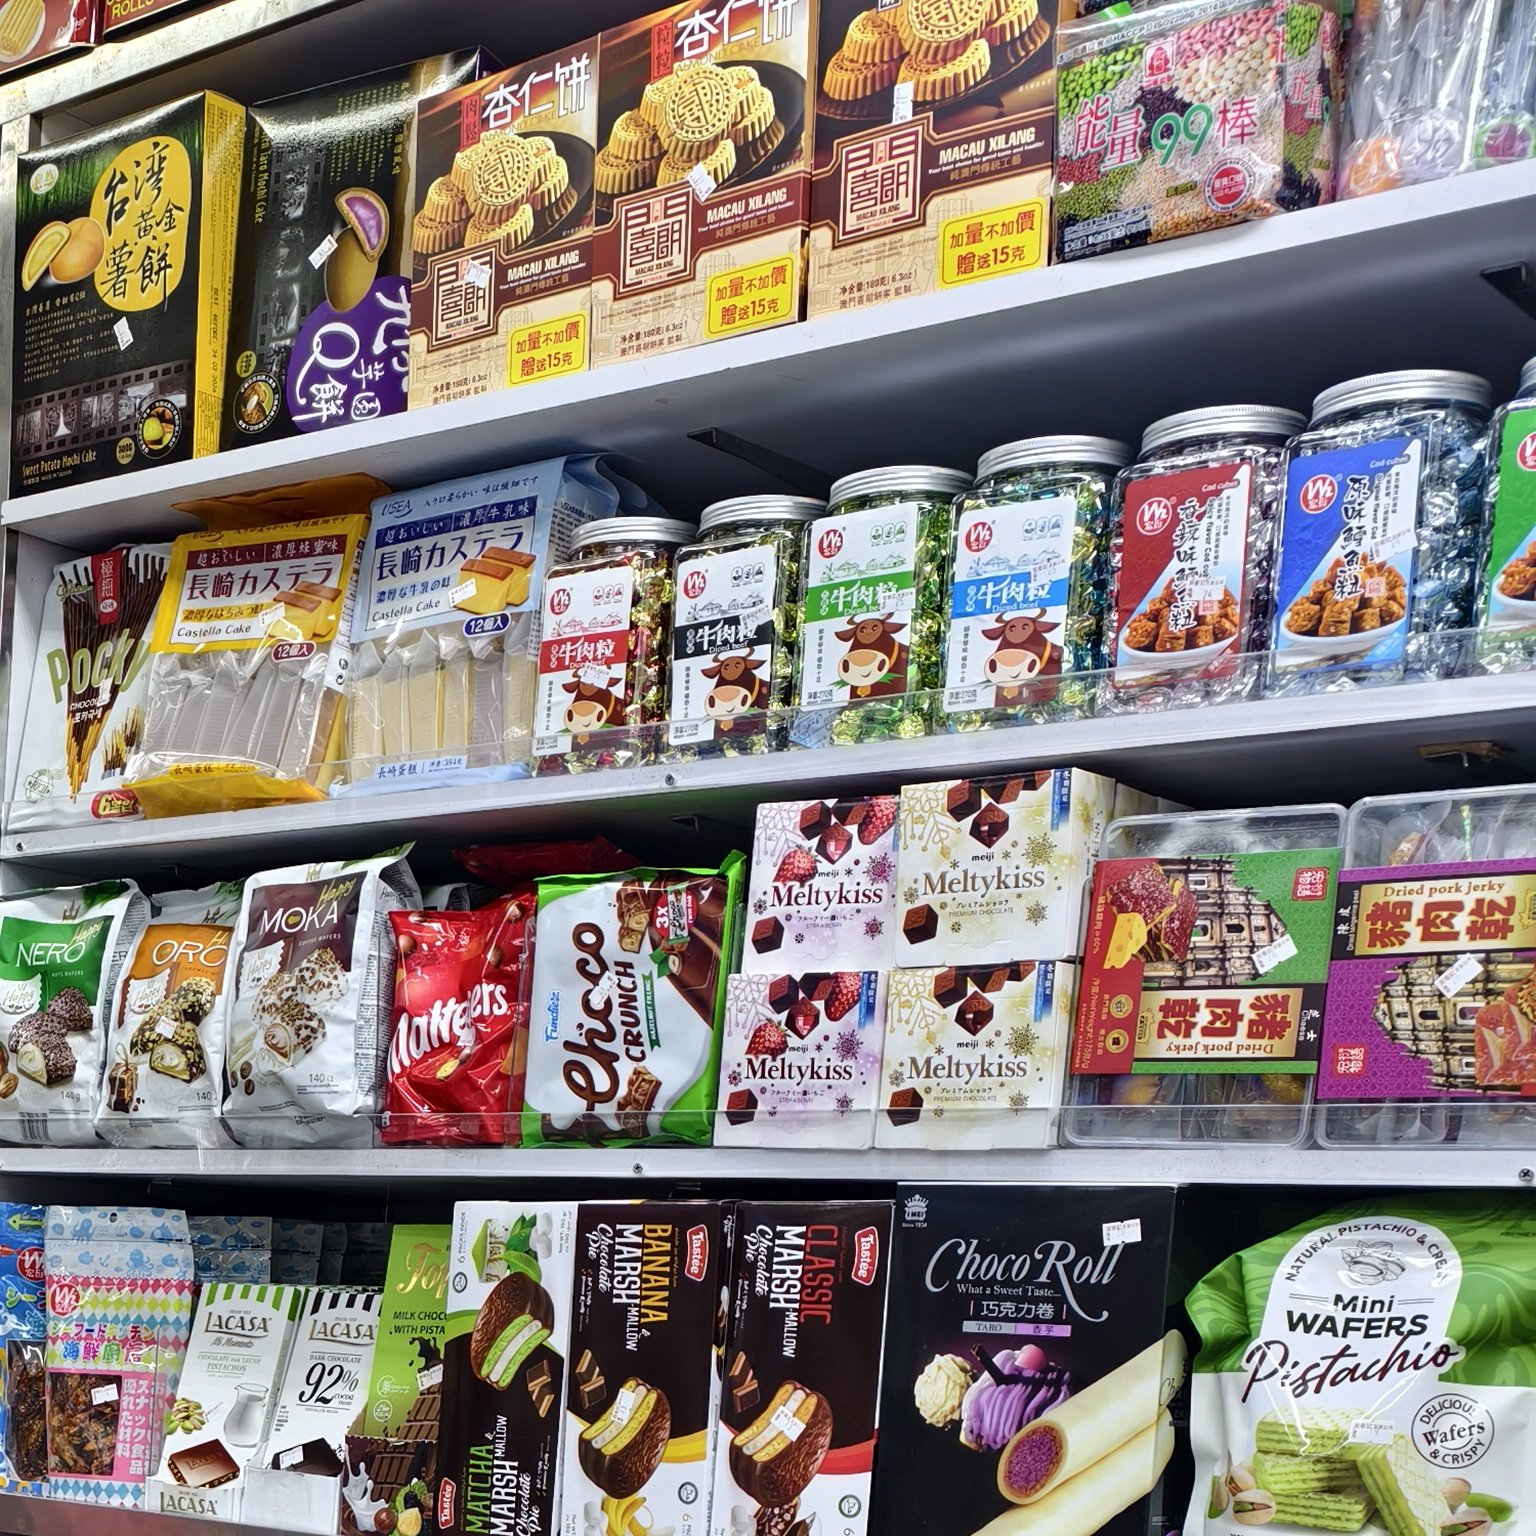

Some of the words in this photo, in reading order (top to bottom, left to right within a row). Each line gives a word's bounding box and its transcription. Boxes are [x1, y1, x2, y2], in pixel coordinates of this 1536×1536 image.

[939, 141, 987, 165] MACAU
[989, 127, 1036, 151] XILANG
[706, 198, 744, 224] MACAU
[745, 186, 788, 213] XILANG
[950, 209, 1037, 249] 加量不加價
[507, 260, 543, 280] MACAU
[544, 249, 580, 271] XILANG
[956, 244, 1026, 277] 贈送15克
[515, 320, 581, 355] 加量不加價
[520, 351, 573, 378] 贈送15克
[22, 463, 41, 478] Sweet
[41, 457, 61, 474] Potato
[82, 450, 97, 462] Cake
[376, 523, 524, 582] 長崎カステラ
[187, 562, 336, 601] 長崎カステラ
[977, 578, 1053, 609] 牛肉粒
[372, 605, 413, 624] Castella
[416, 598, 441, 612] Cake
[468, 614, 506, 633] 12個入
[177, 625, 222, 639] Castella
[225, 623, 252, 635] Cake
[558, 638, 616, 666] 牛肉粒
[970, 852, 996, 863] meiji
[769, 883, 884, 915] Meltykiss
[920, 868, 1046, 904] Meltykiss
[1382, 884, 1424, 898] Dried
[1427, 883, 1460, 898] pork
[1463, 880, 1505, 896] jerky
[261, 902, 339, 935] MOKA
[16, 940, 87, 967] NERO
[624, 960, 648, 1064] CRUNCH
[744, 1055, 854, 1086] Meltykiss
[906, 1054, 1028, 1087] Meltykiss
[1284, 1232, 1337, 1282] NATURAL
[1337, 1223, 1418, 1238] PISTACHIO
[639, 1223, 674, 1324] BANANA
[802, 1224, 833, 1325] CLASSIC
[923, 1237, 1037, 1295] Choco
[1031, 1240, 1124, 1323] Roll
[979, 1300, 1055, 1320] 巧克力卷
[1332, 1293, 1396, 1314] Mini
[204, 1312, 272, 1335] LACASA
[975, 1322, 1003, 1333] TARO
[1031, 1323, 1055, 1335] 香芋
[1286, 1310, 1430, 1339] WAFERS
[206, 1363, 247, 1373] PISTACHOS
[309, 1354, 325, 1363] DARK
[326, 1355, 362, 1364] CHOCOLATE
[1241, 1330, 1460, 1404] Pistachio
[299, 1361, 360, 1405] 92%
[1422, 1419, 1486, 1447] Wafers
[160, 1489, 218, 1515] LACASA
[465, 1443, 494, 1536] MATCHA
